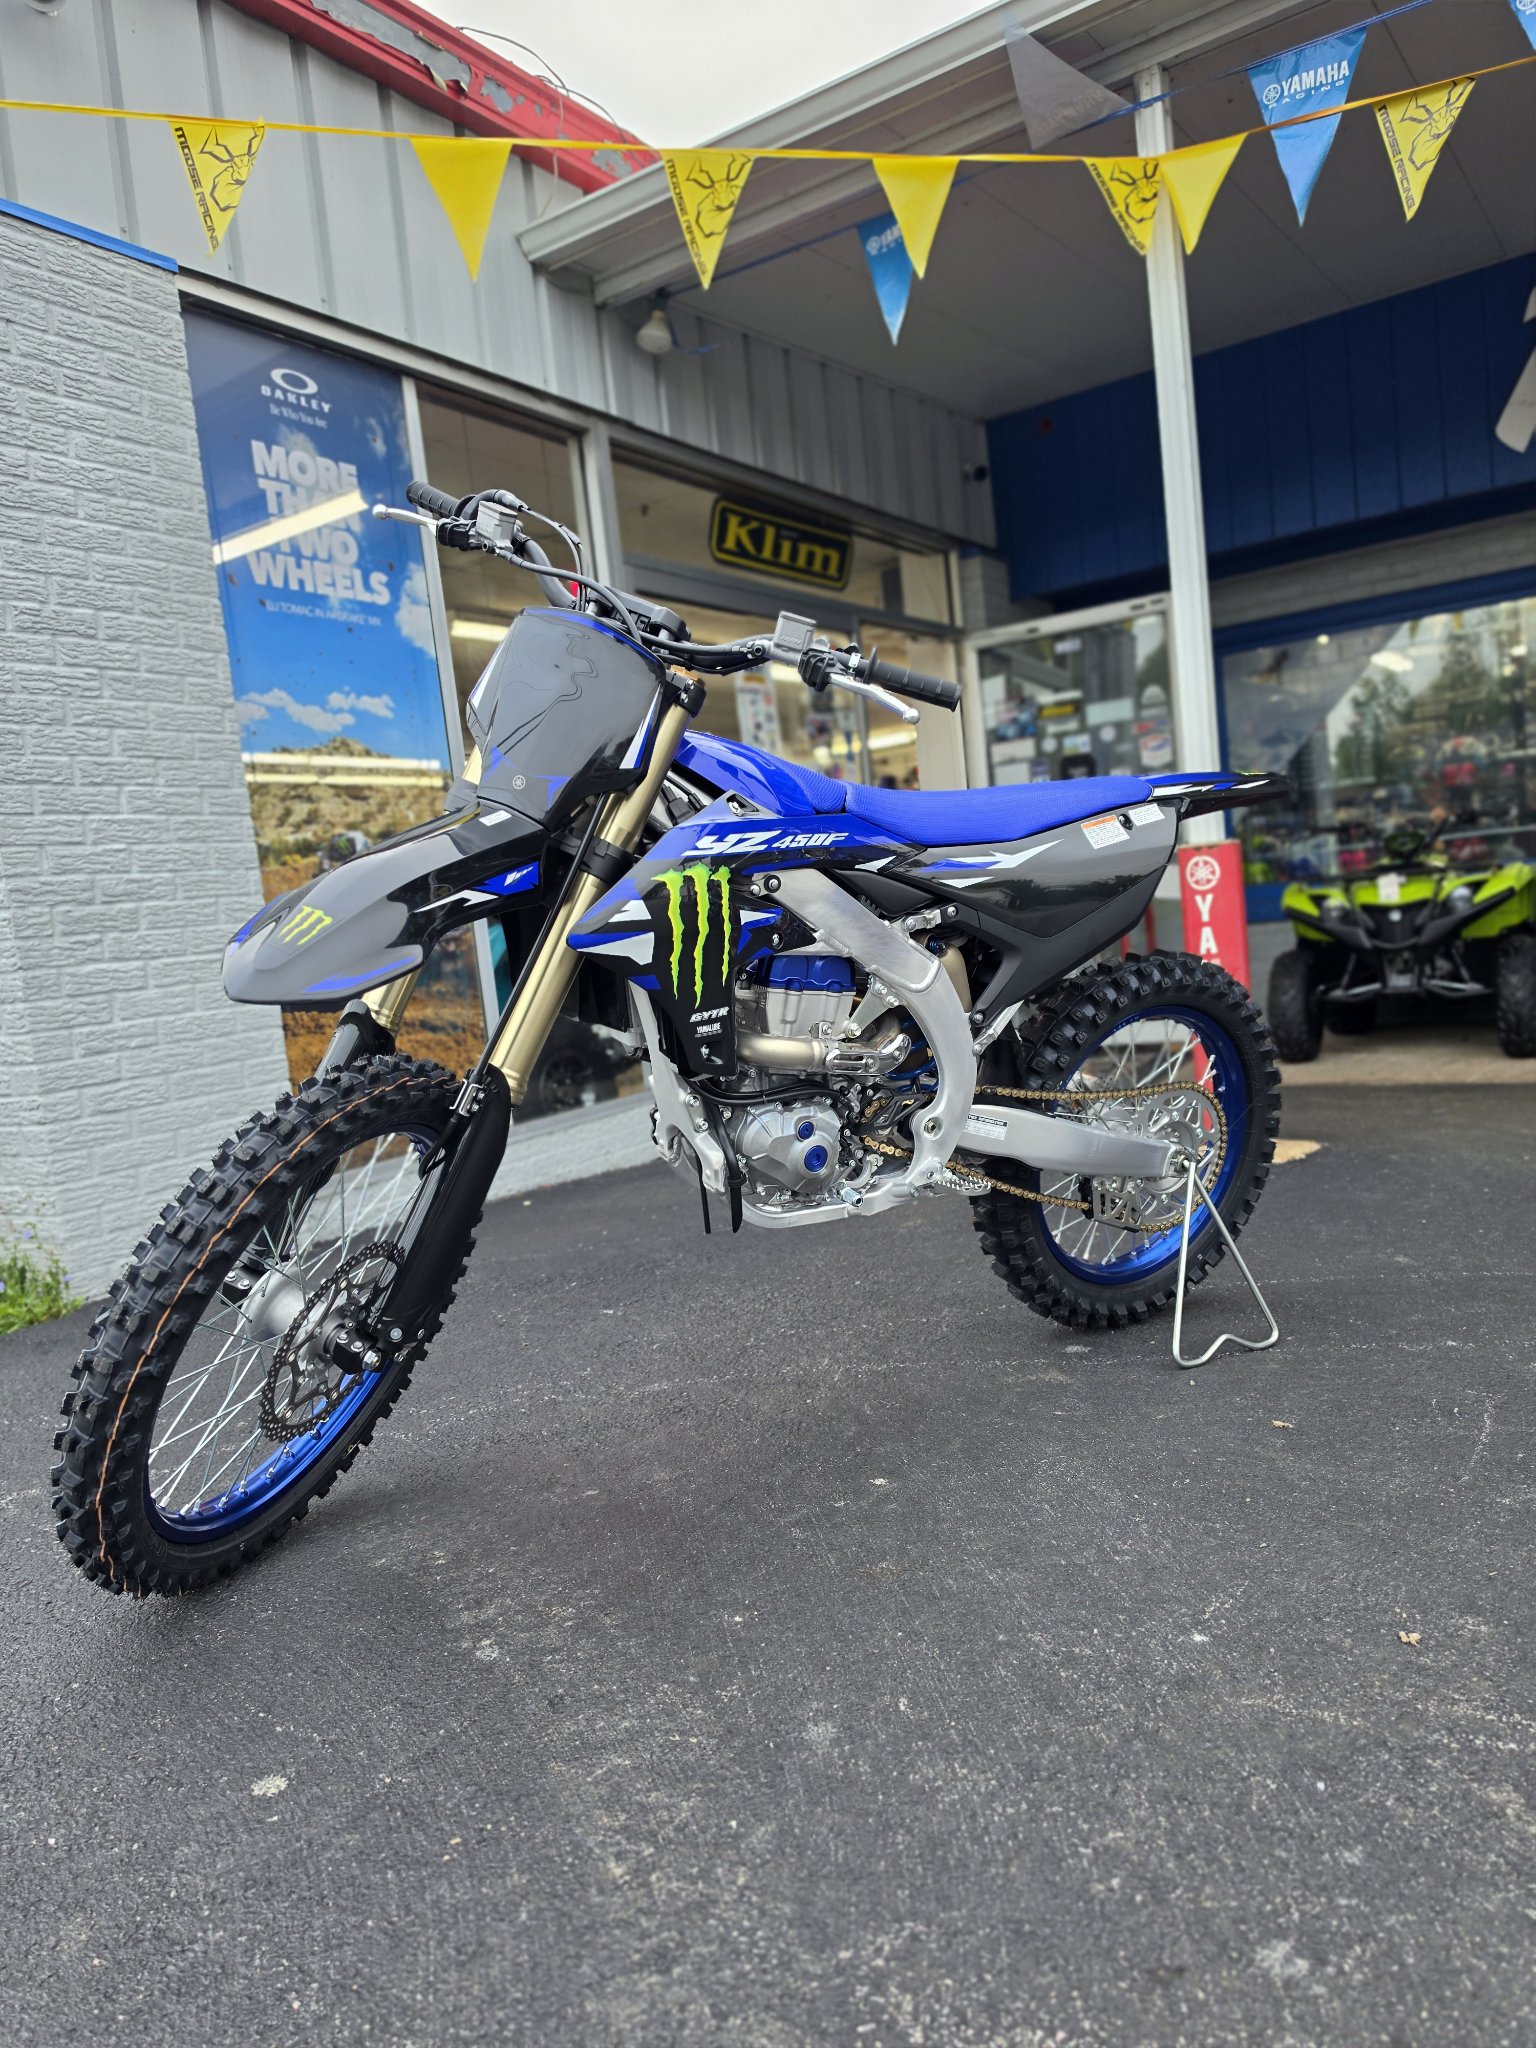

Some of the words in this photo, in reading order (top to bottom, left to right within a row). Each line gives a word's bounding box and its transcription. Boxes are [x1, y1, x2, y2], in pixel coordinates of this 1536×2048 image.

[1281, 60, 1350, 97] YAMAHA
[174, 126, 203, 190] MOOSE
[195, 190, 220, 252] RACING
[261, 385, 332, 413] OAKLEY
[251, 439, 359, 493] MORE
[722, 511, 842, 579] Klim
[247, 549, 392, 606] WHEELS
[680, 830, 783, 857] YZ
[771, 832, 849, 849] 450F
[689, 1006, 730, 1023] GYTR
